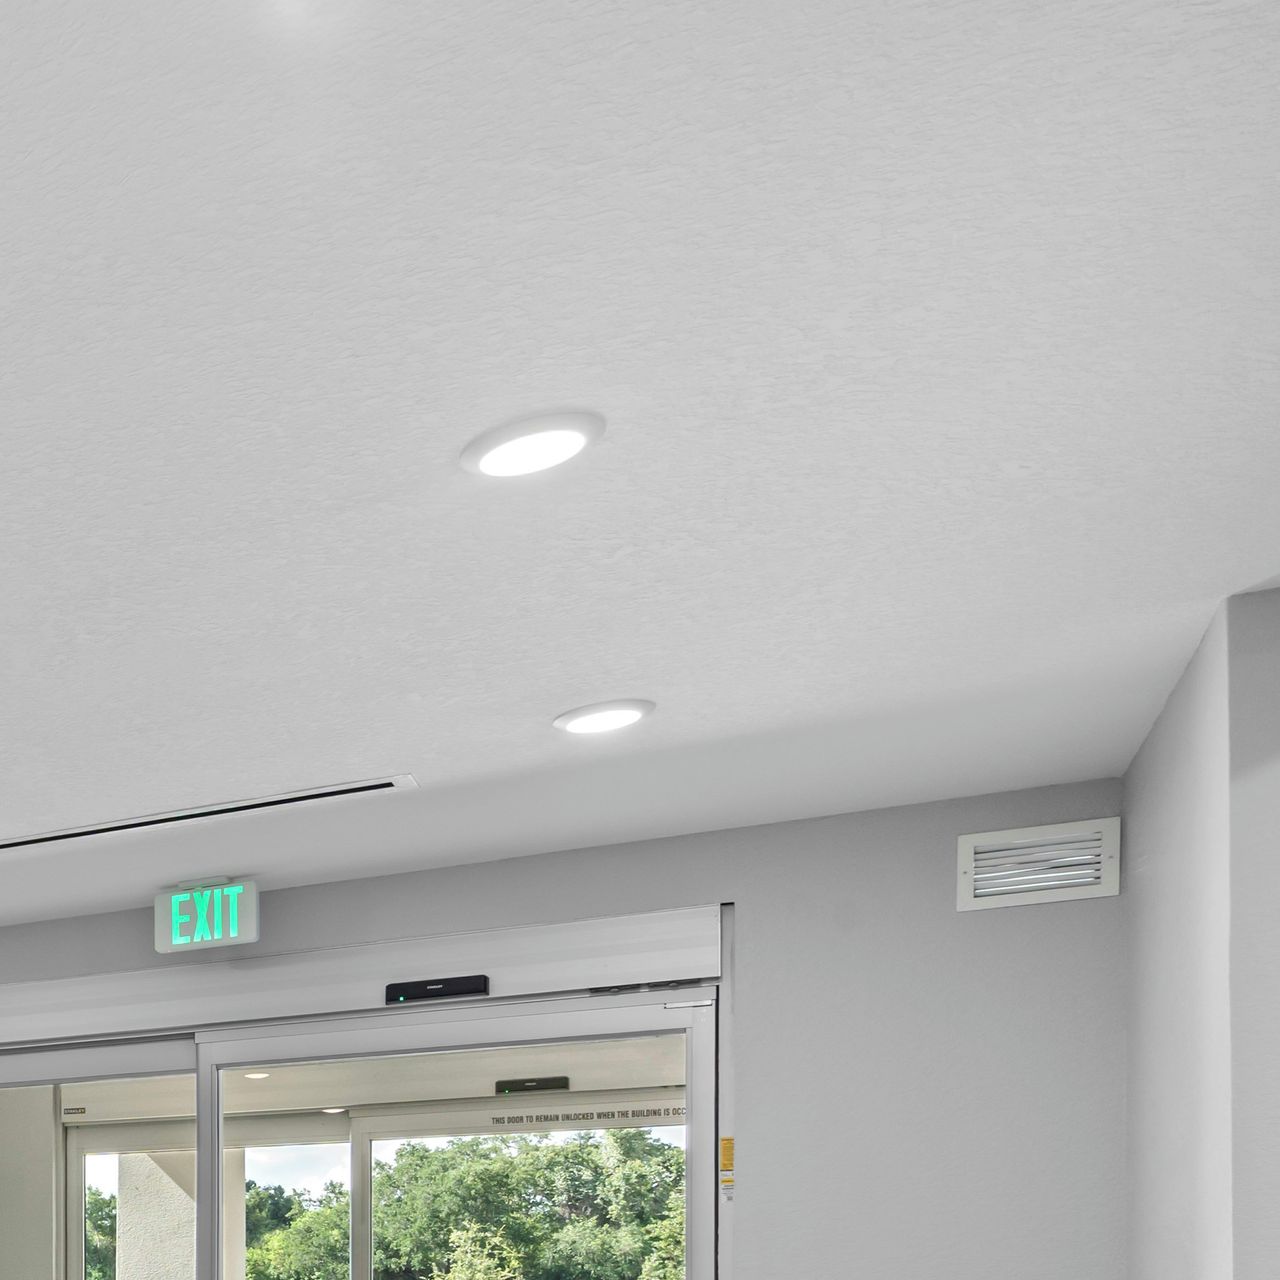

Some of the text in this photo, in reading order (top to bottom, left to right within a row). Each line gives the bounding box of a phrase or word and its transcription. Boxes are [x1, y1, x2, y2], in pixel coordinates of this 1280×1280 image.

[171, 885, 244, 945] EXIT
[492, 1117, 505, 1125] THIS
[507, 1115, 524, 1124] DOOR
[526, 1115, 534, 1123] TO
[536, 1114, 560, 1122] REMAIN
[561, 1112, 594, 1121] UNLOCKED
[596, 1111, 615, 1119] WHEN
[617, 1110, 629, 1118] THE
[631, 1109, 662, 1118] BUILDING
[664, 1108, 670, 1116] IS
